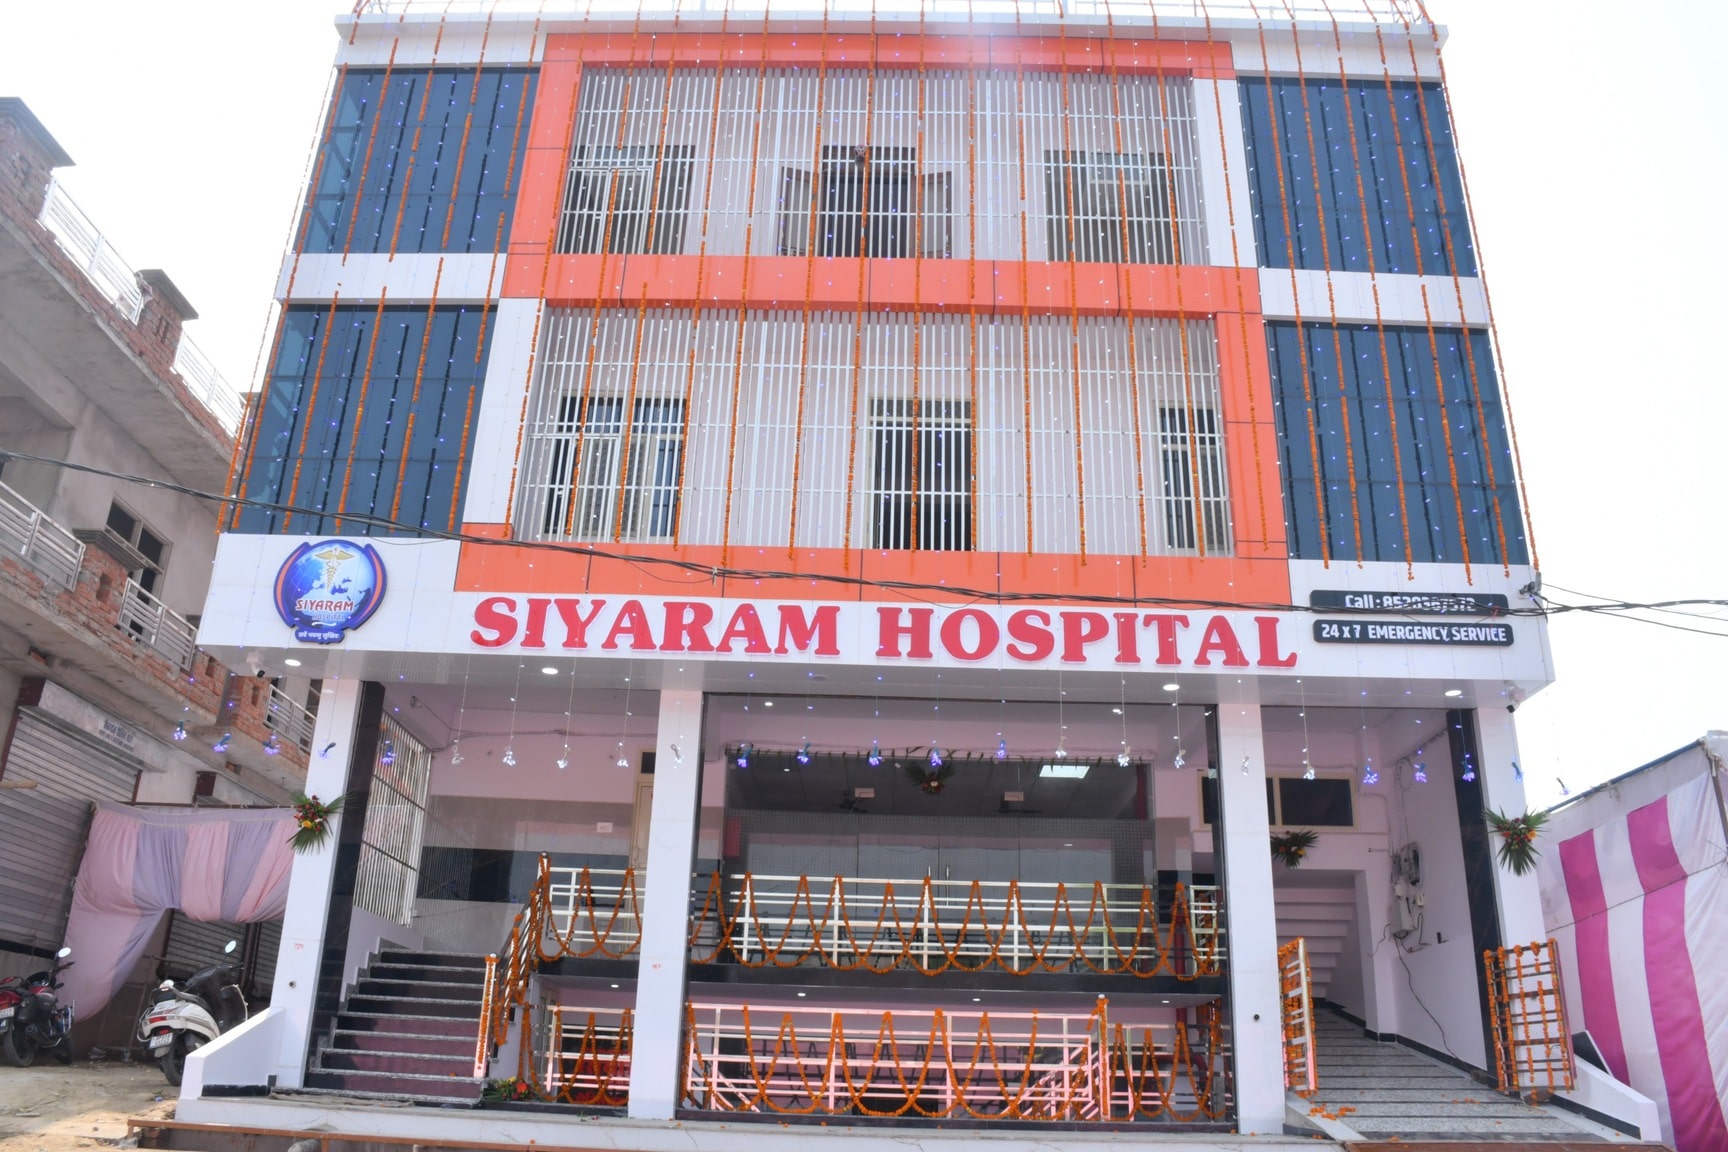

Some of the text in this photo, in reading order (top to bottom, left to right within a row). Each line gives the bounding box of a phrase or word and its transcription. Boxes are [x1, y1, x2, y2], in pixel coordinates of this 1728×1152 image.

[296, 599, 354, 611] SIYARAM
[313, 613, 344, 621] HOSPITAL
[470, 597, 1298, 669] SIYARAM HOSPITAL
[1321, 623, 1339, 639] 24
[1368, 625, 1448, 641] EMERGENCY
[1452, 627, 1507, 642] SERVICE
